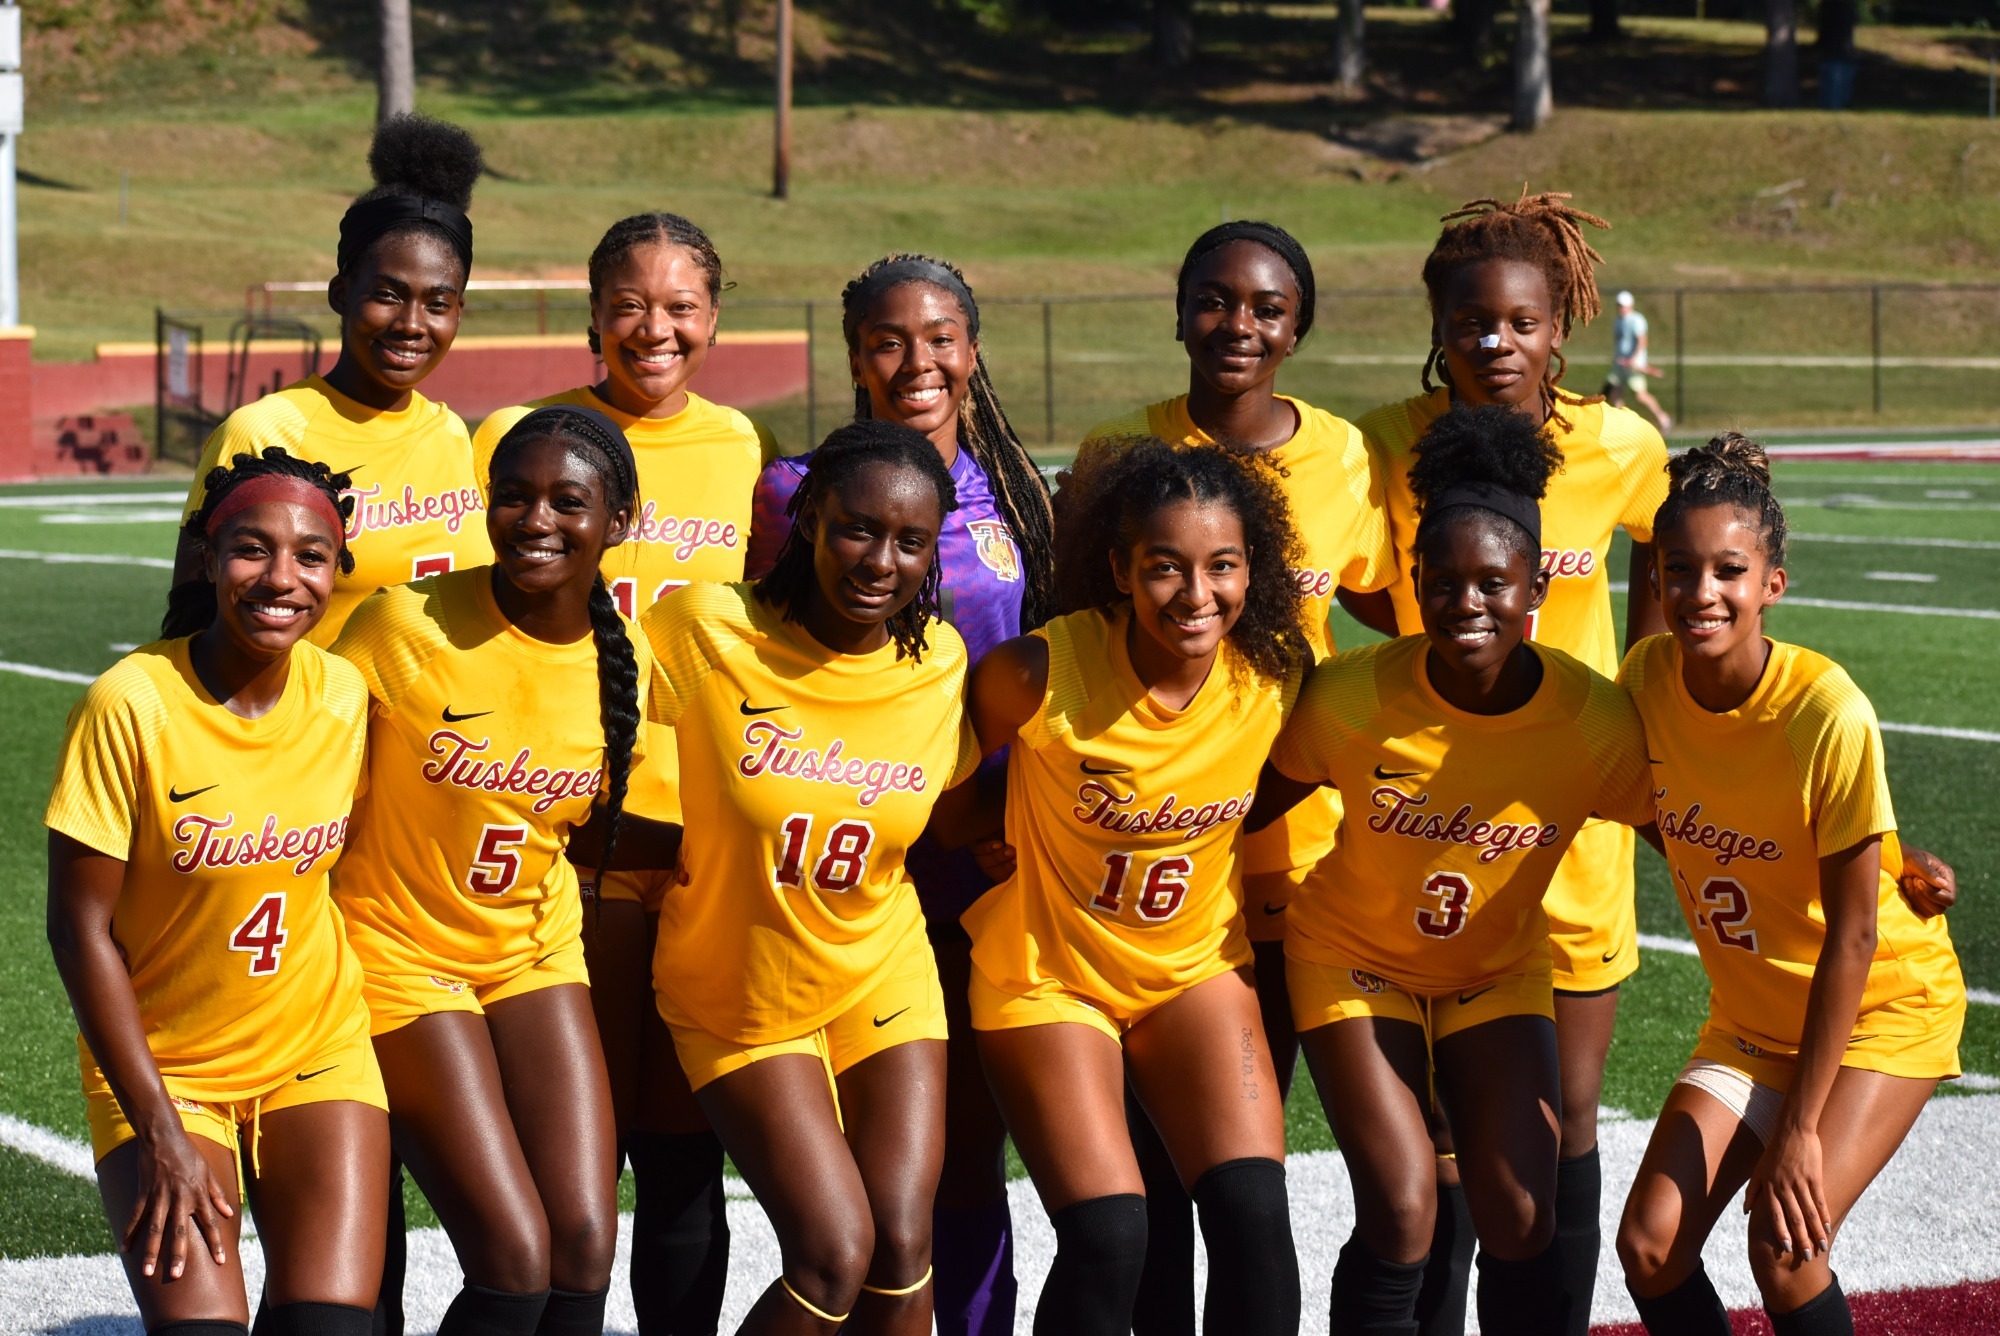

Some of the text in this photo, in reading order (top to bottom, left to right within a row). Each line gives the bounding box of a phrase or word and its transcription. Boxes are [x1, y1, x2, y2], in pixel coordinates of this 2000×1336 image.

[338, 483, 485, 535] Tuskegee
[421, 729, 602, 814] Tuskegee
[738, 720, 927, 807] Tuskegee
[1072, 780, 1254, 840] Tuskegee
[1367, 785, 1560, 864] Tuskegee
[1653, 787, 1784, 866] skegee
[465, 823, 528, 897] 5
[773, 812, 875, 893] 18
[1089, 850, 1194, 922] 16
[228, 892, 289, 977] 4
[1413, 870, 1474, 939] 3
